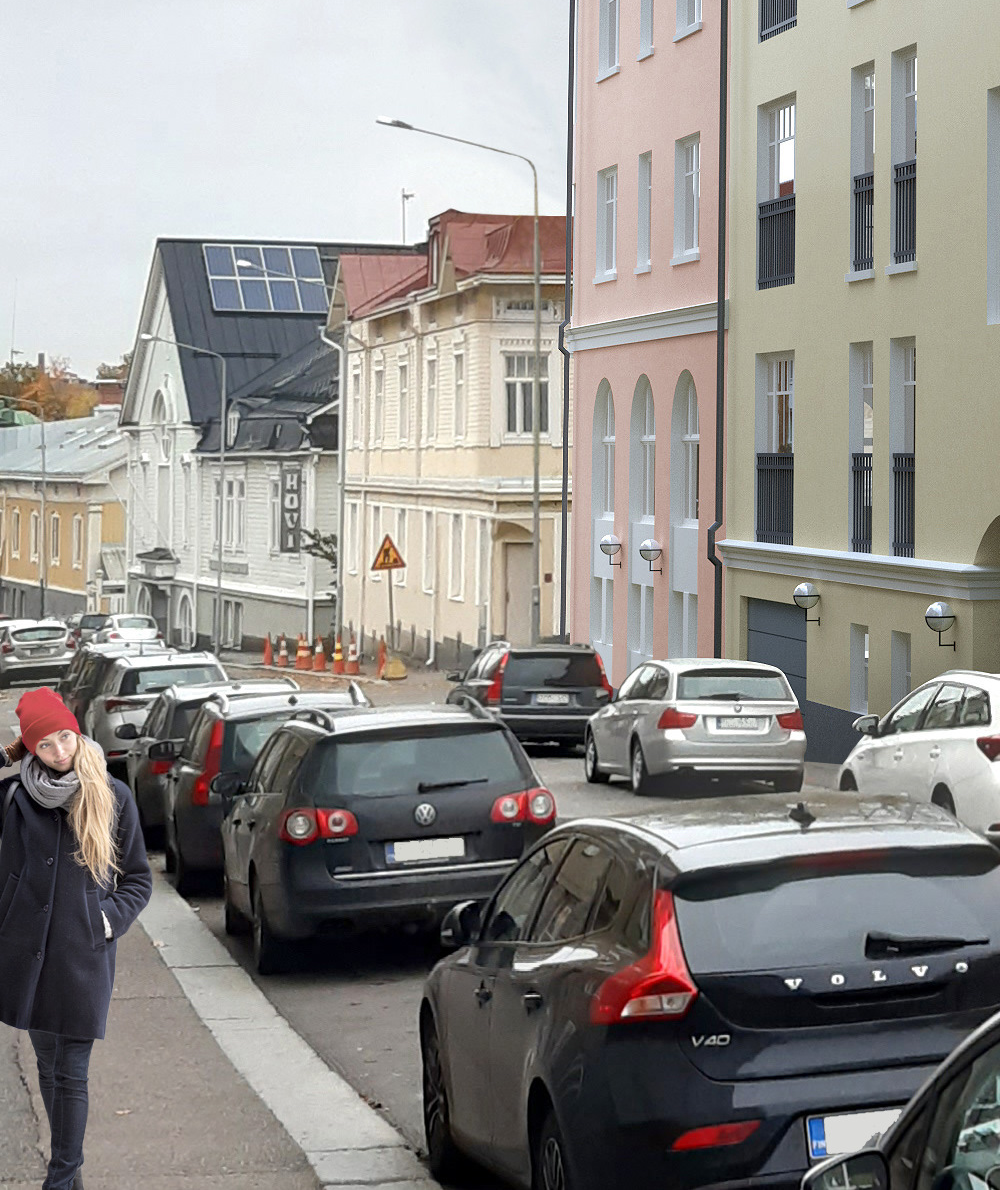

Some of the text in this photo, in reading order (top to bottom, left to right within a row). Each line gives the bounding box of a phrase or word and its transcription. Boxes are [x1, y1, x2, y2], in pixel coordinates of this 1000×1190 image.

[284, 473, 299, 548] HOVI
[784, 962, 969, 990] VOLVO
[691, 1034, 731, 1048] V40
